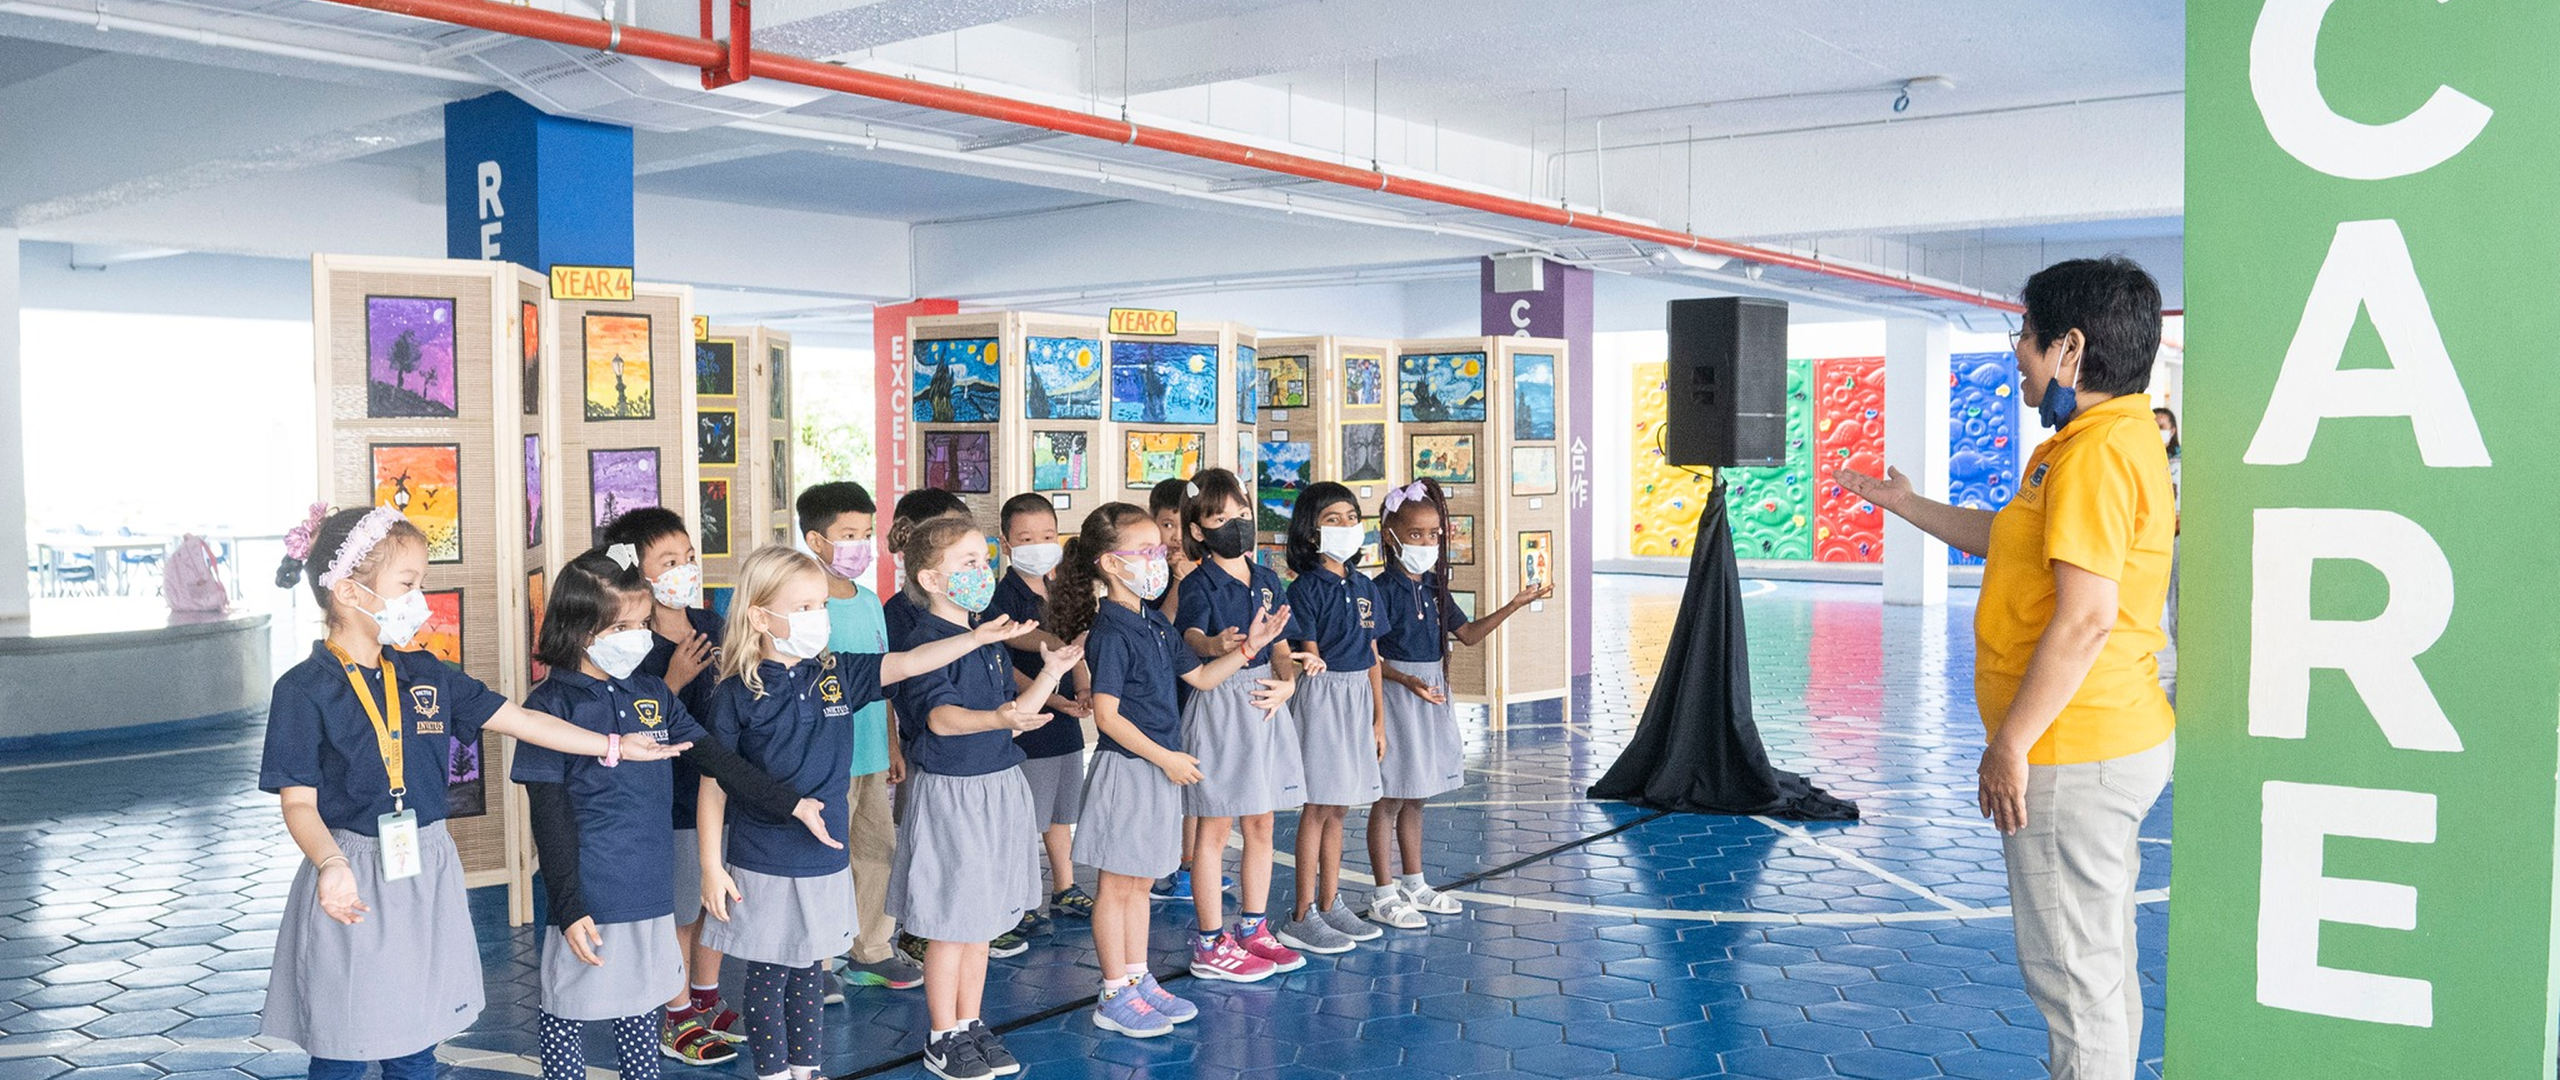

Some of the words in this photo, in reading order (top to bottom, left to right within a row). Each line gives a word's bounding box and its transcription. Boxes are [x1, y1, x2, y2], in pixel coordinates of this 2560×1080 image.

[556, 270, 613, 297] YEAR
[614, 272, 630, 297] 4
[691, 317, 704, 337] 3
[1114, 311, 1157, 332] YEAR
[1161, 313, 1174, 333] 6
[1570, 436, 1589, 509] 合作
[2242, 0, 2494, 1028] CARE
